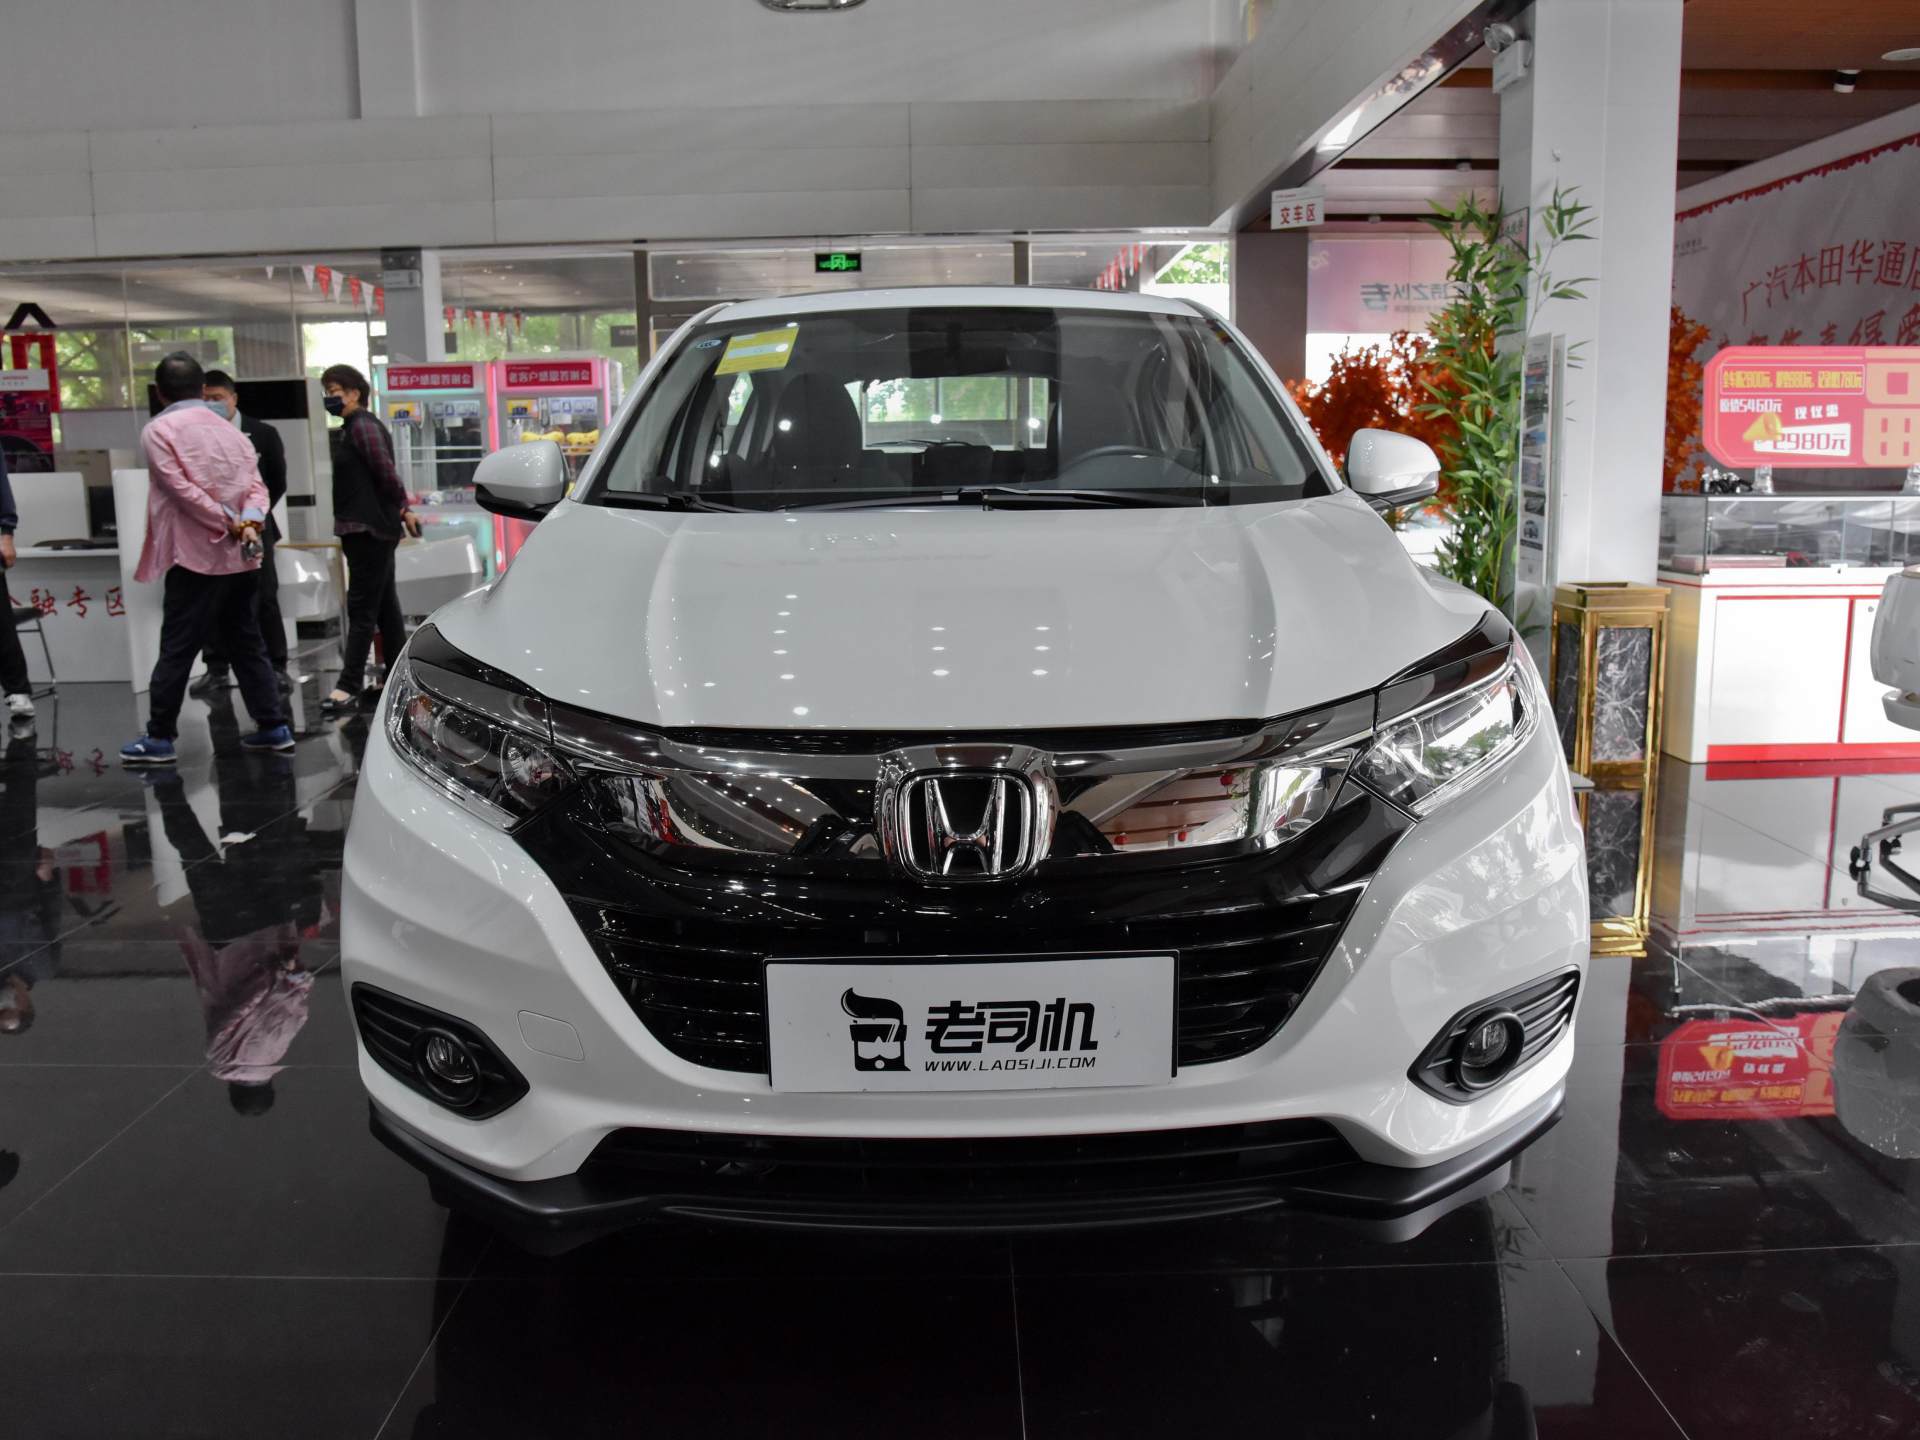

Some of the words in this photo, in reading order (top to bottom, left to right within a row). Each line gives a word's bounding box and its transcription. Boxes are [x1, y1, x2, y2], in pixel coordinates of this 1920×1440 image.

[1279, 203, 1316, 225] 交车区
[8, 585, 126, 619] 融专区
[924, 997, 1098, 1054] 老司机
[924, 1056, 1096, 1072] WWW.LAOSIJI.COM
